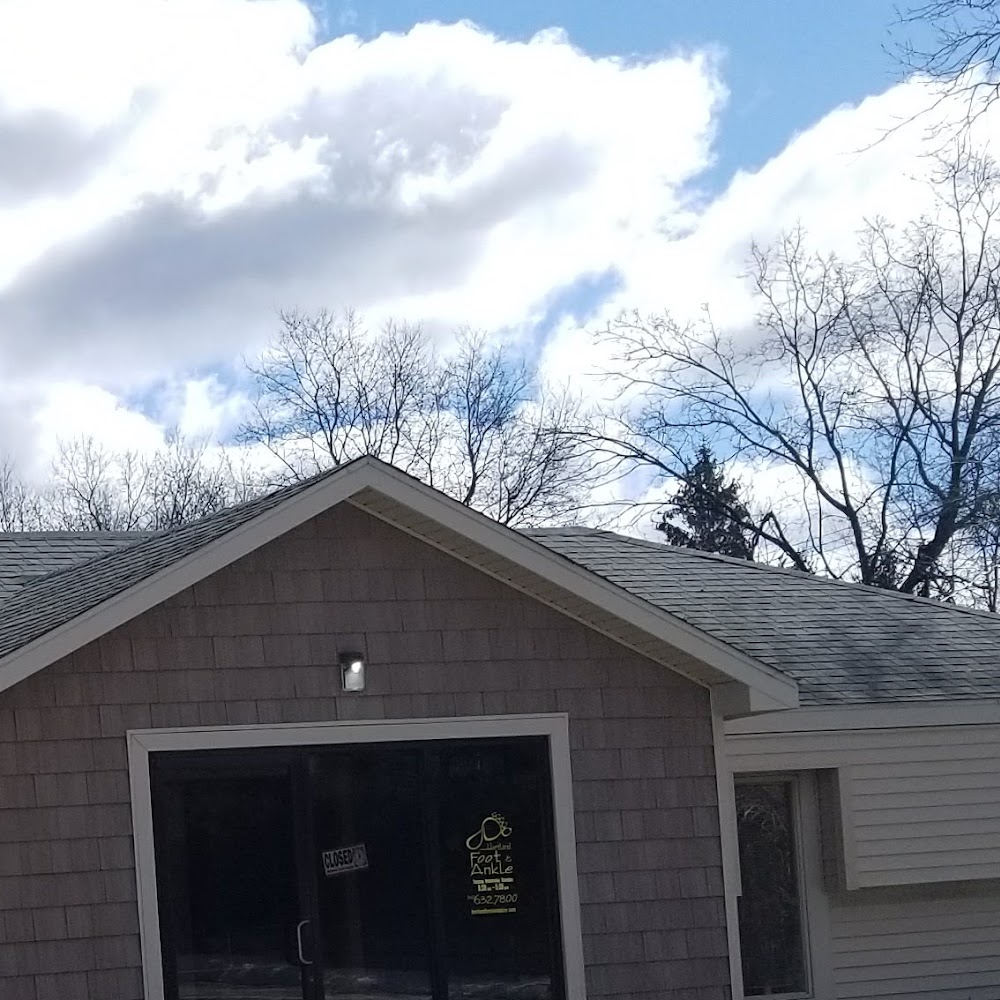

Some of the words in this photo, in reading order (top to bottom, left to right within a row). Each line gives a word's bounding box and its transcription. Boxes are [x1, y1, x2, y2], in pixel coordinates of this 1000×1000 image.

[324, 849, 353, 868] CLOSED
[470, 850, 501, 868] Foot
[470, 862, 513, 876] Ankle
